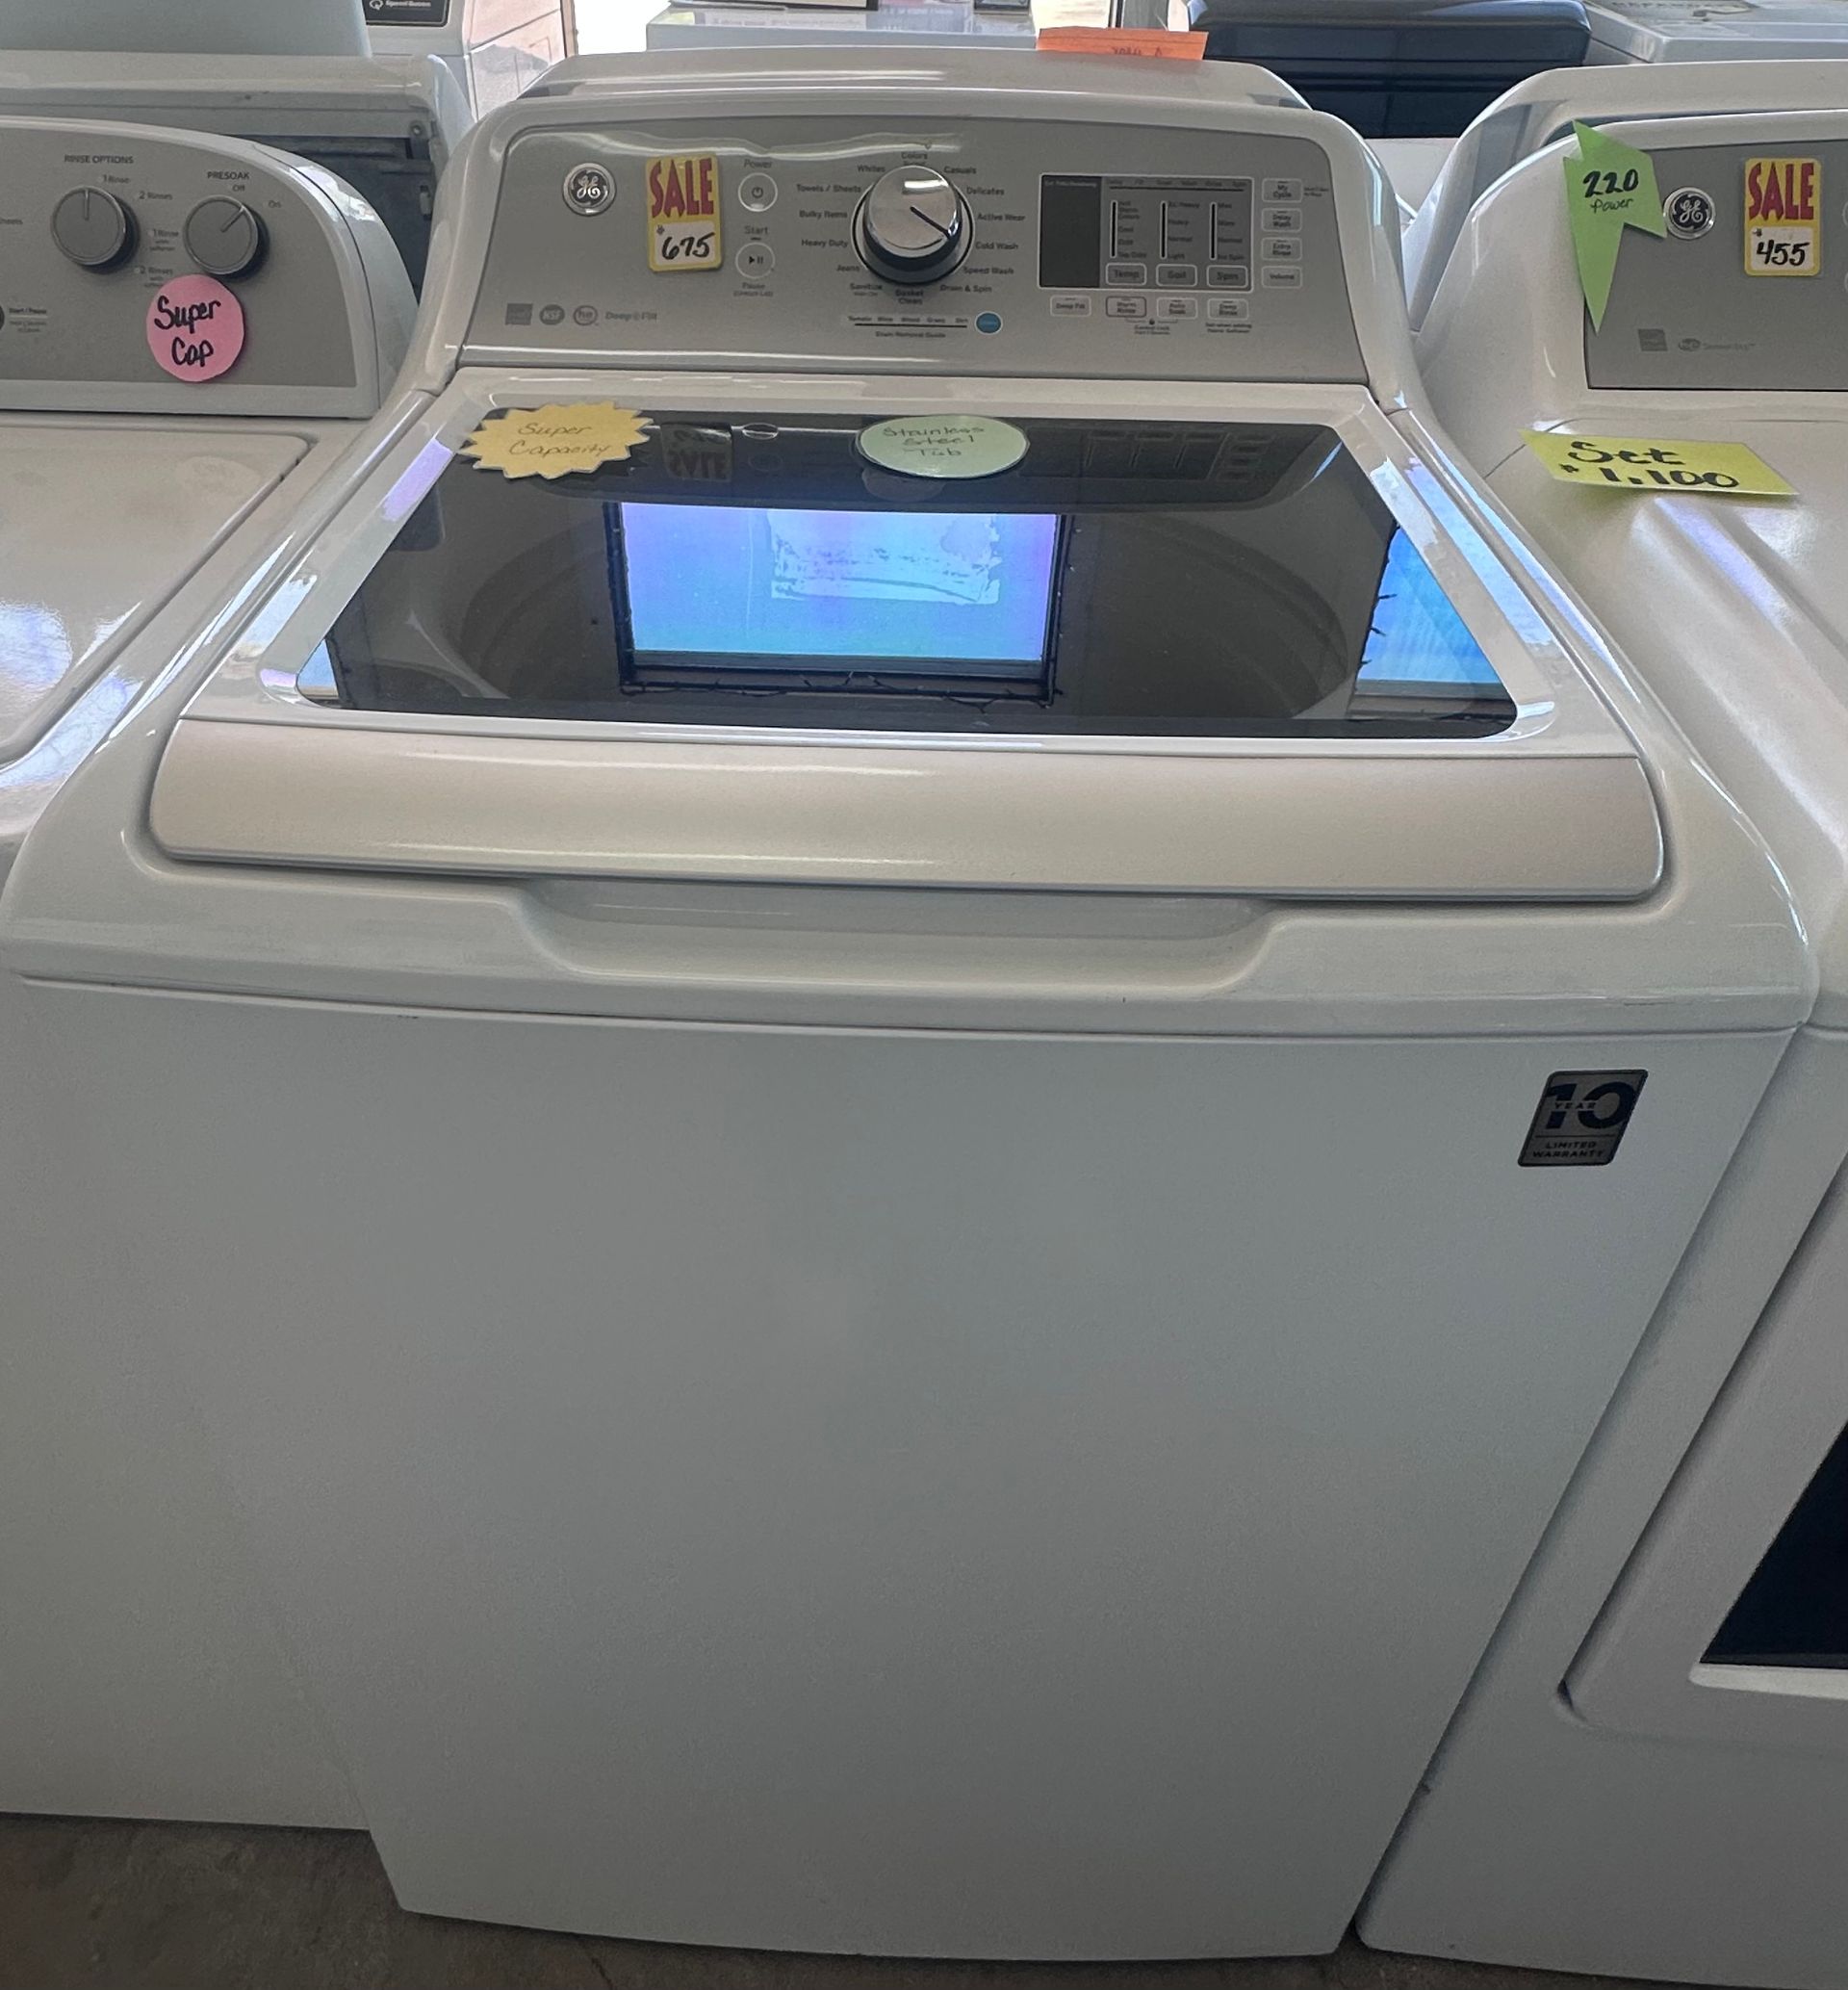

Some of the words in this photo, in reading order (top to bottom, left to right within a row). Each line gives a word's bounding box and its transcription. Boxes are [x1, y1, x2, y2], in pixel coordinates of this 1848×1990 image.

[64, 155, 90, 164] RINSE
[92, 155, 134, 164] OPTIONS
[744, 159, 772, 168] Power
[944, 166, 976, 174] Casuals
[207, 171, 249, 180] PRESOAK
[1582, 168, 1639, 198] 220
[649, 158, 715, 219] SALE
[796, 184, 823, 193] Towels
[834, 185, 861, 194] Sheets
[966, 187, 1004, 195] Delicates
[1748, 162, 1815, 221] SALE
[800, 210, 823, 220] Bulky
[977, 213, 1003, 221] Active
[802, 240, 829, 248] Heavy
[832, 240, 848, 248] Duty
[963, 267, 989, 276] Speed
[154, 296, 220, 333] Super
[518, 423, 593, 436] Super
[883, 426, 985, 437] Stainless
[902, 435, 974, 445] Steel
[507, 441, 611, 455] Capacity
[901, 448, 962, 456] Tub
[1568, 441, 1685, 466] Set
[1545, 1081, 1636, 1129] 10
[1545, 1141, 1597, 1150] LIMITED
